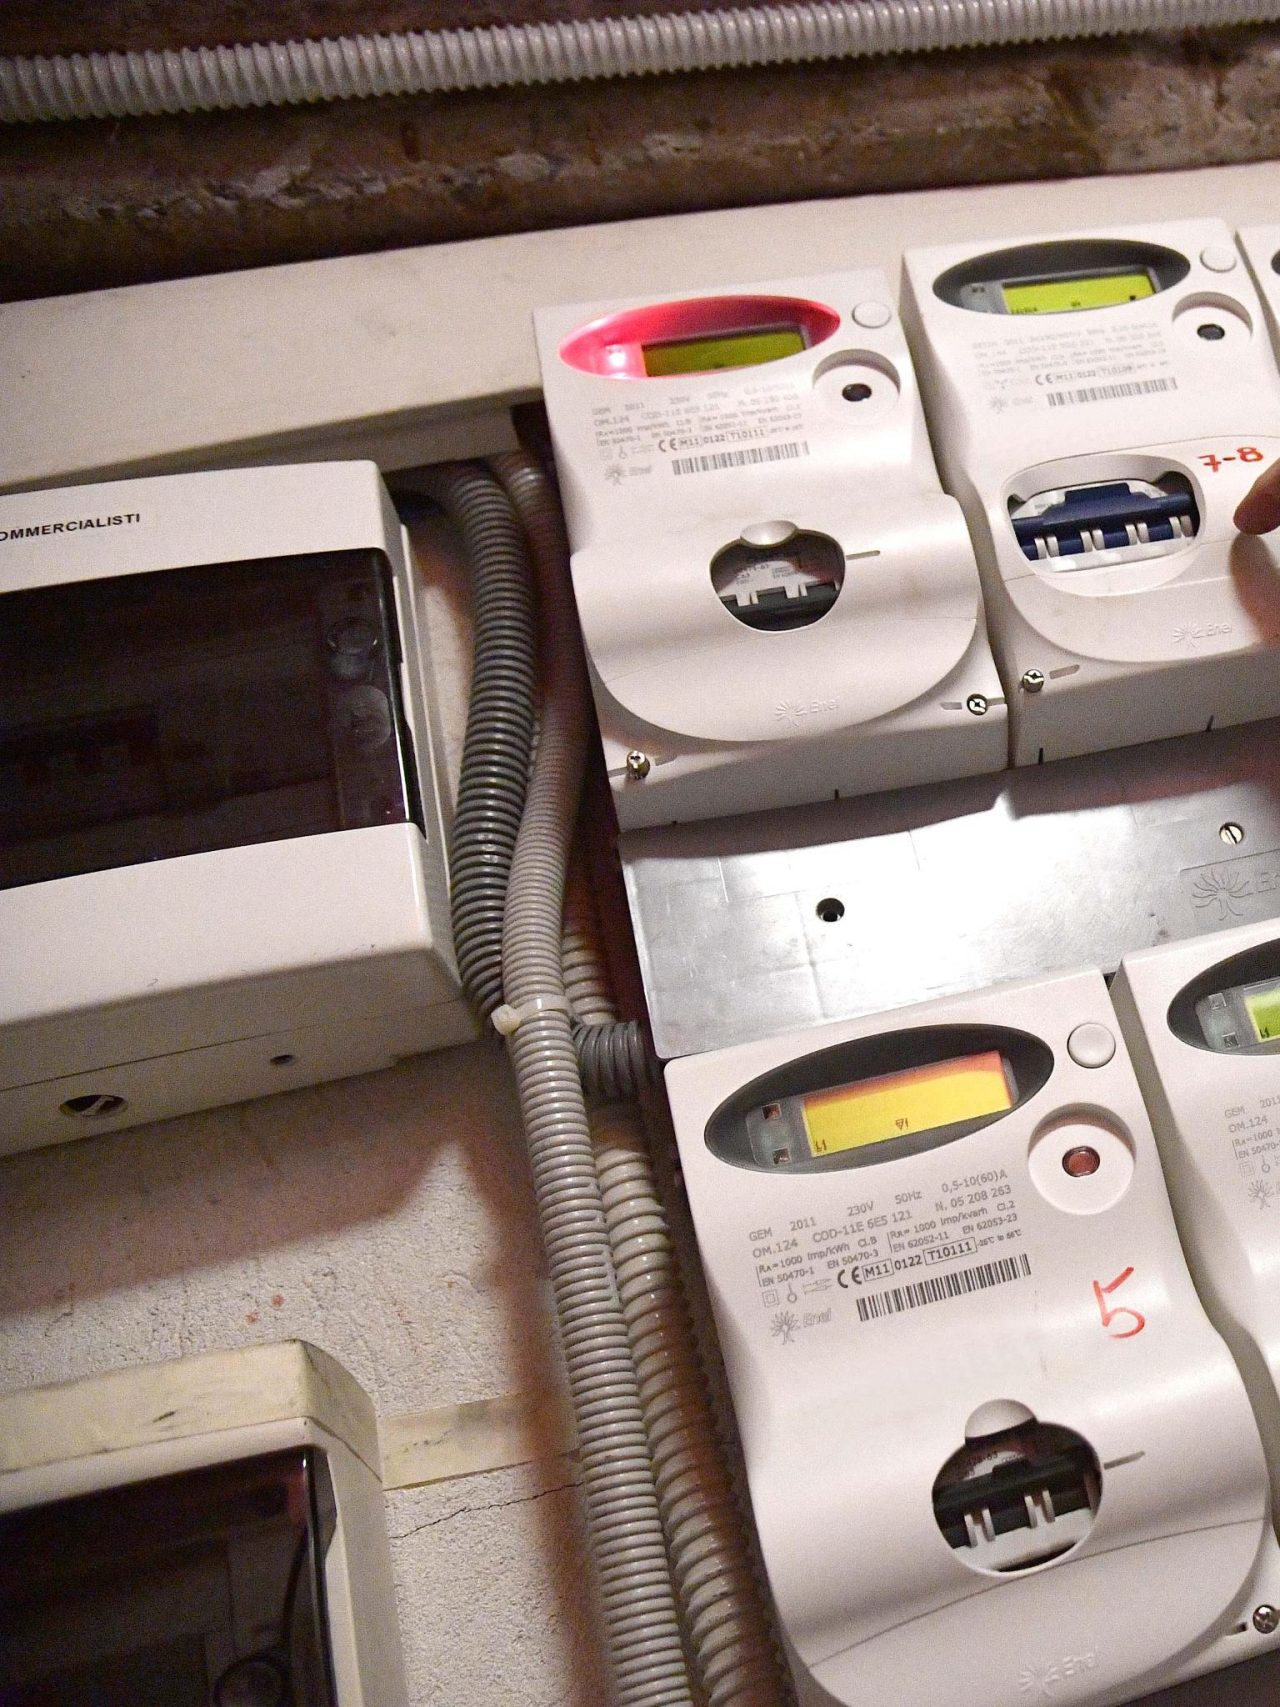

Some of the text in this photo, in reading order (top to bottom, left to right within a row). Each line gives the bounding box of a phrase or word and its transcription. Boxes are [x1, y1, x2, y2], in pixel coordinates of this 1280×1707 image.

[1198, 447, 1263, 472] 7-8
[749, 1169, 1008, 1241] GEM 2011 230V 50Hz 0,5-10(60)A
[752, 1238, 798, 1258] OM.124
[812, 1221, 865, 1243] COD-11E
[892, 1210, 913, 1223] 121
[935, 1201, 948, 1212] N.
[950, 1197, 964, 1208] 05
[967, 1190, 988, 1204] 208
[892, 1212, 1018, 1253] EN 62052-11 EN 62053-23
[914, 1221, 937, 1234] 1000
[761, 1249, 879, 1287] EN 50470-1 EN 50470-3
[864, 1263, 890, 1279] M11
[894, 1254, 923, 1271] 0122
[927, 1241, 972, 1261] T10111
[1093, 1266, 1146, 1339] 5
